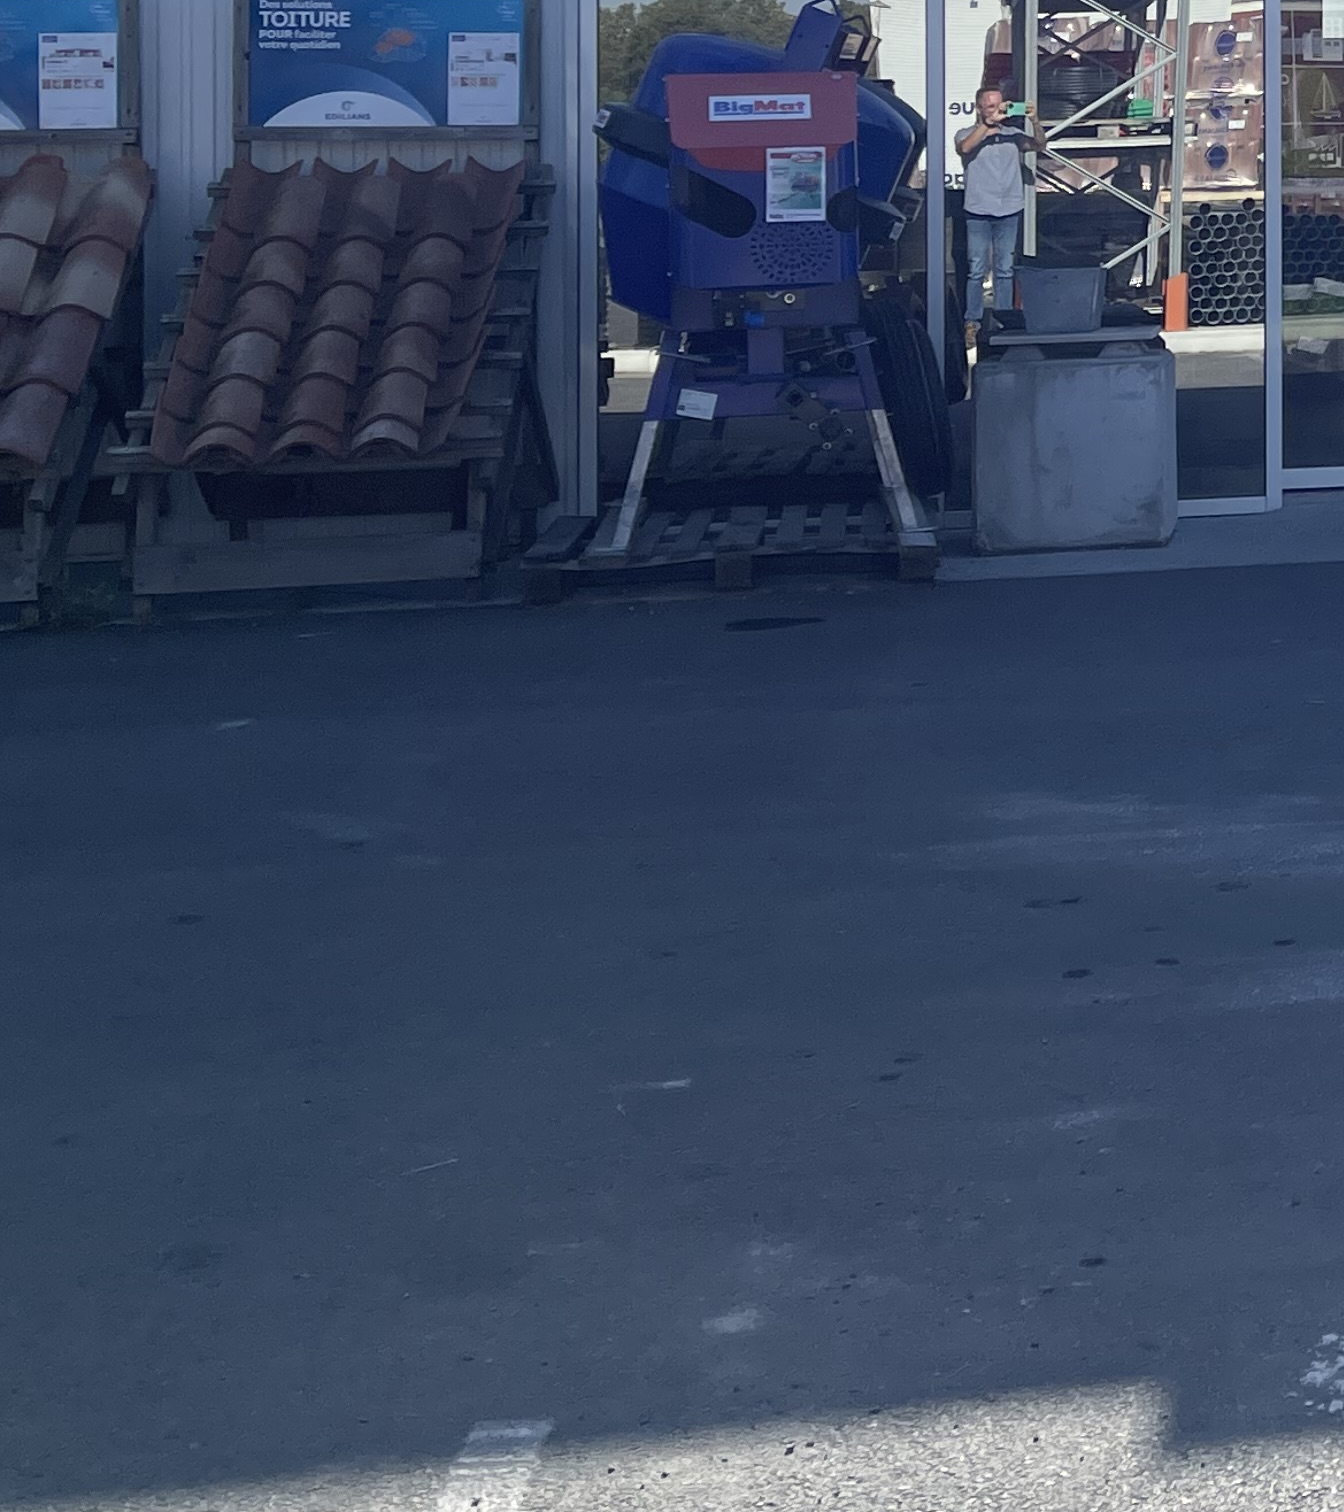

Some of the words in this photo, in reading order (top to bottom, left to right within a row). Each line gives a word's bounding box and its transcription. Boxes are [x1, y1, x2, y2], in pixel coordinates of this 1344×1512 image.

[258, 11, 352, 27] TOITURE
[259, 29, 293, 39] POUR
[713, 100, 806, 116] BigMat
